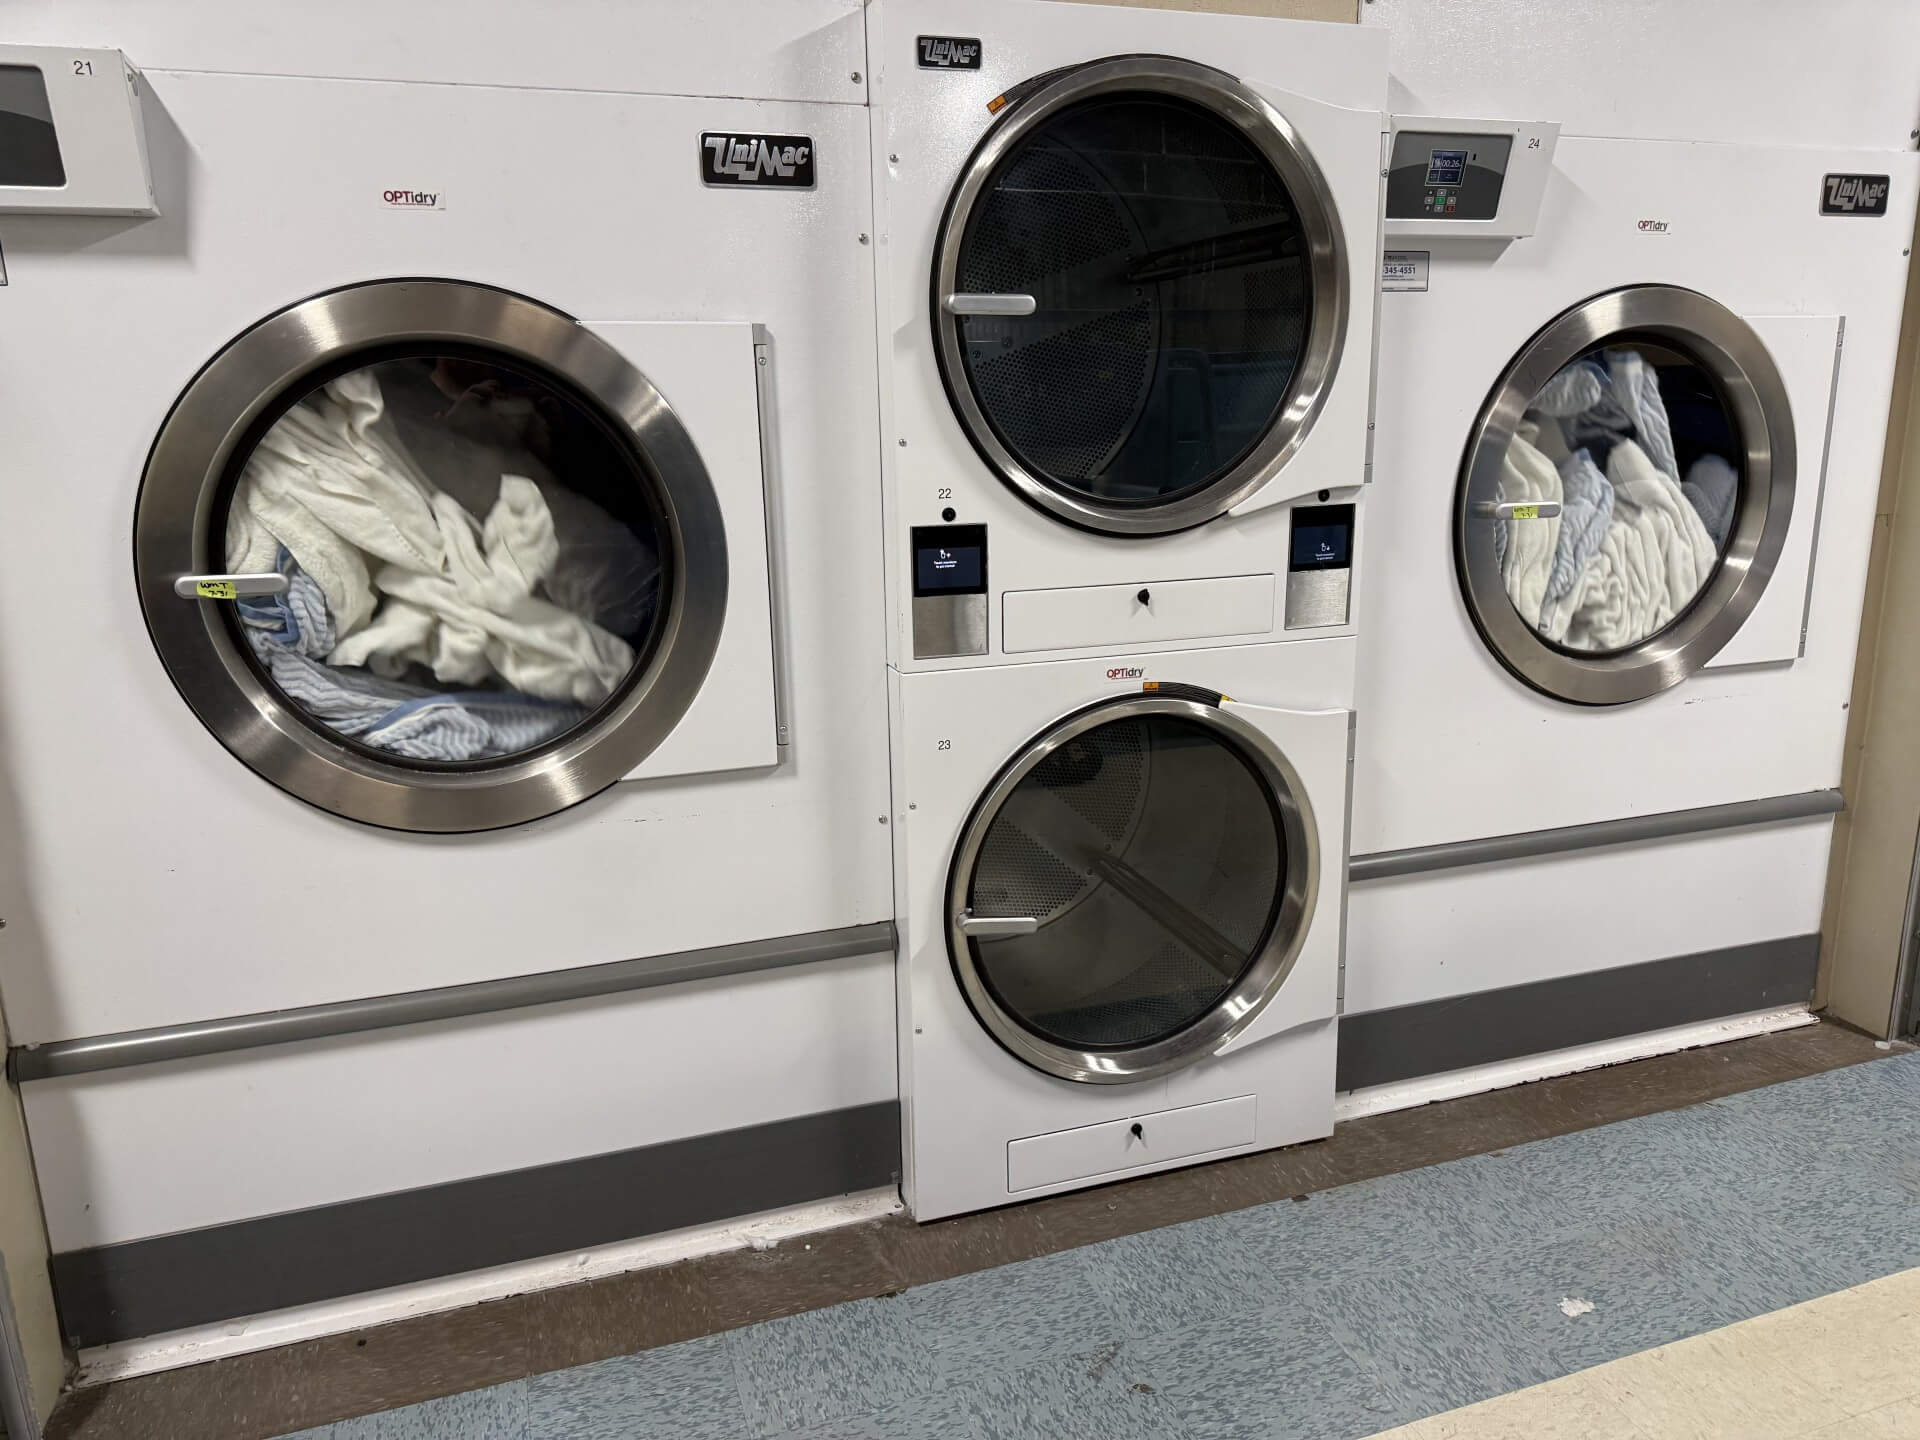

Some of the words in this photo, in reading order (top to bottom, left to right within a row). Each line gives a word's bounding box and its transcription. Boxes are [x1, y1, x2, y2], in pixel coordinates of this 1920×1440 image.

[920, 40, 976, 65] UniMac
[74, 61, 92, 75] 21
[1528, 138, 1541, 149] 24
[705, 137, 809, 180] UniMac
[383, 190, 437, 206] OPTidry
[1827, 178, 1886, 210] UniMac
[1638, 220, 1668, 232] OPTidry
[938, 488, 952, 499] 22
[1106, 667, 1144, 679] OPTidry
[938, 739, 951, 751] 23
